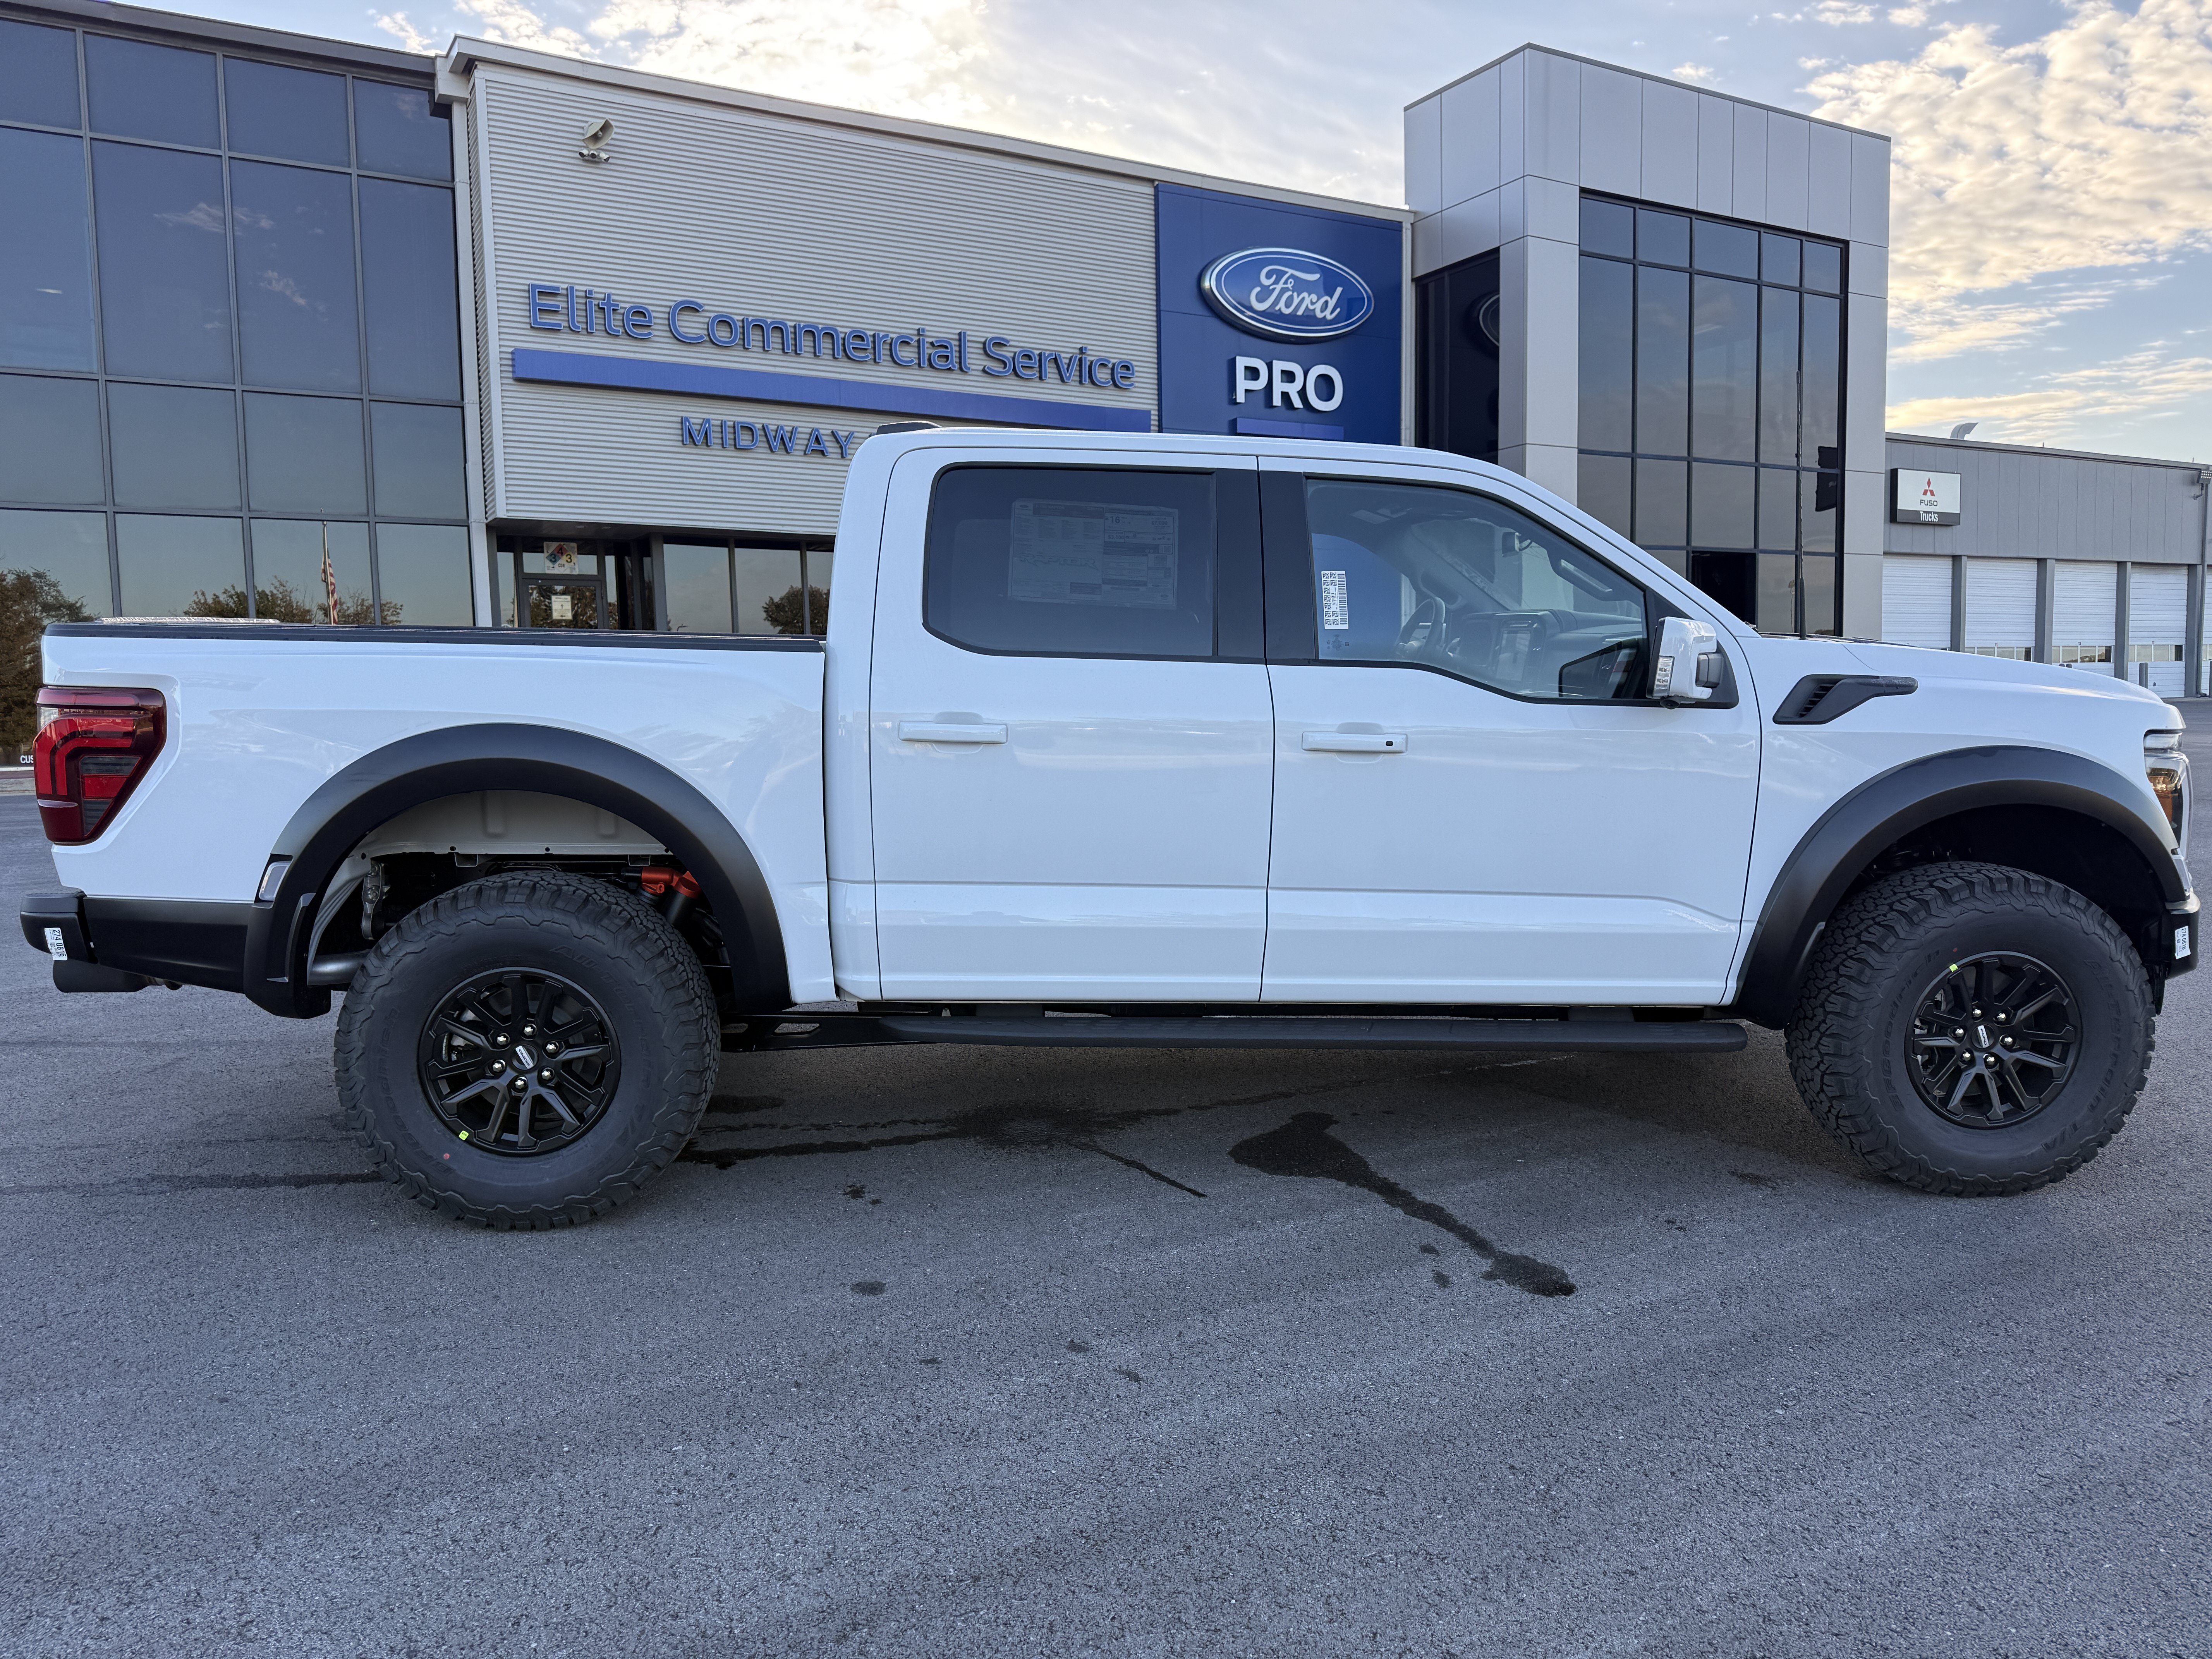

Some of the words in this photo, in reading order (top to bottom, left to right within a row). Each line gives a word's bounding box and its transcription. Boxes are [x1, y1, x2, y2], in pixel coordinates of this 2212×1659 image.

[1250, 266, 1343, 320] Ford
[528, 282, 654, 339] Elite
[669, 300, 971, 373] Commercial
[982, 337, 1137, 389] Service
[1236, 356, 1343, 411] PRO
[682, 416, 855, 459] MIDWAY
[1920, 511, 1938, 522] Trucks
[550, 553, 556, 562] 3
[557, 547, 563, 555] 4
[566, 554, 572, 563] 3
[1019, 553, 1099, 570] RAPTOR
[53, 929, 62, 940] 274
[56, 943, 66, 957] 0816
[1881, 949, 1940, 1112] BFGoodrich
[519, 1049, 530, 1066] FORD
